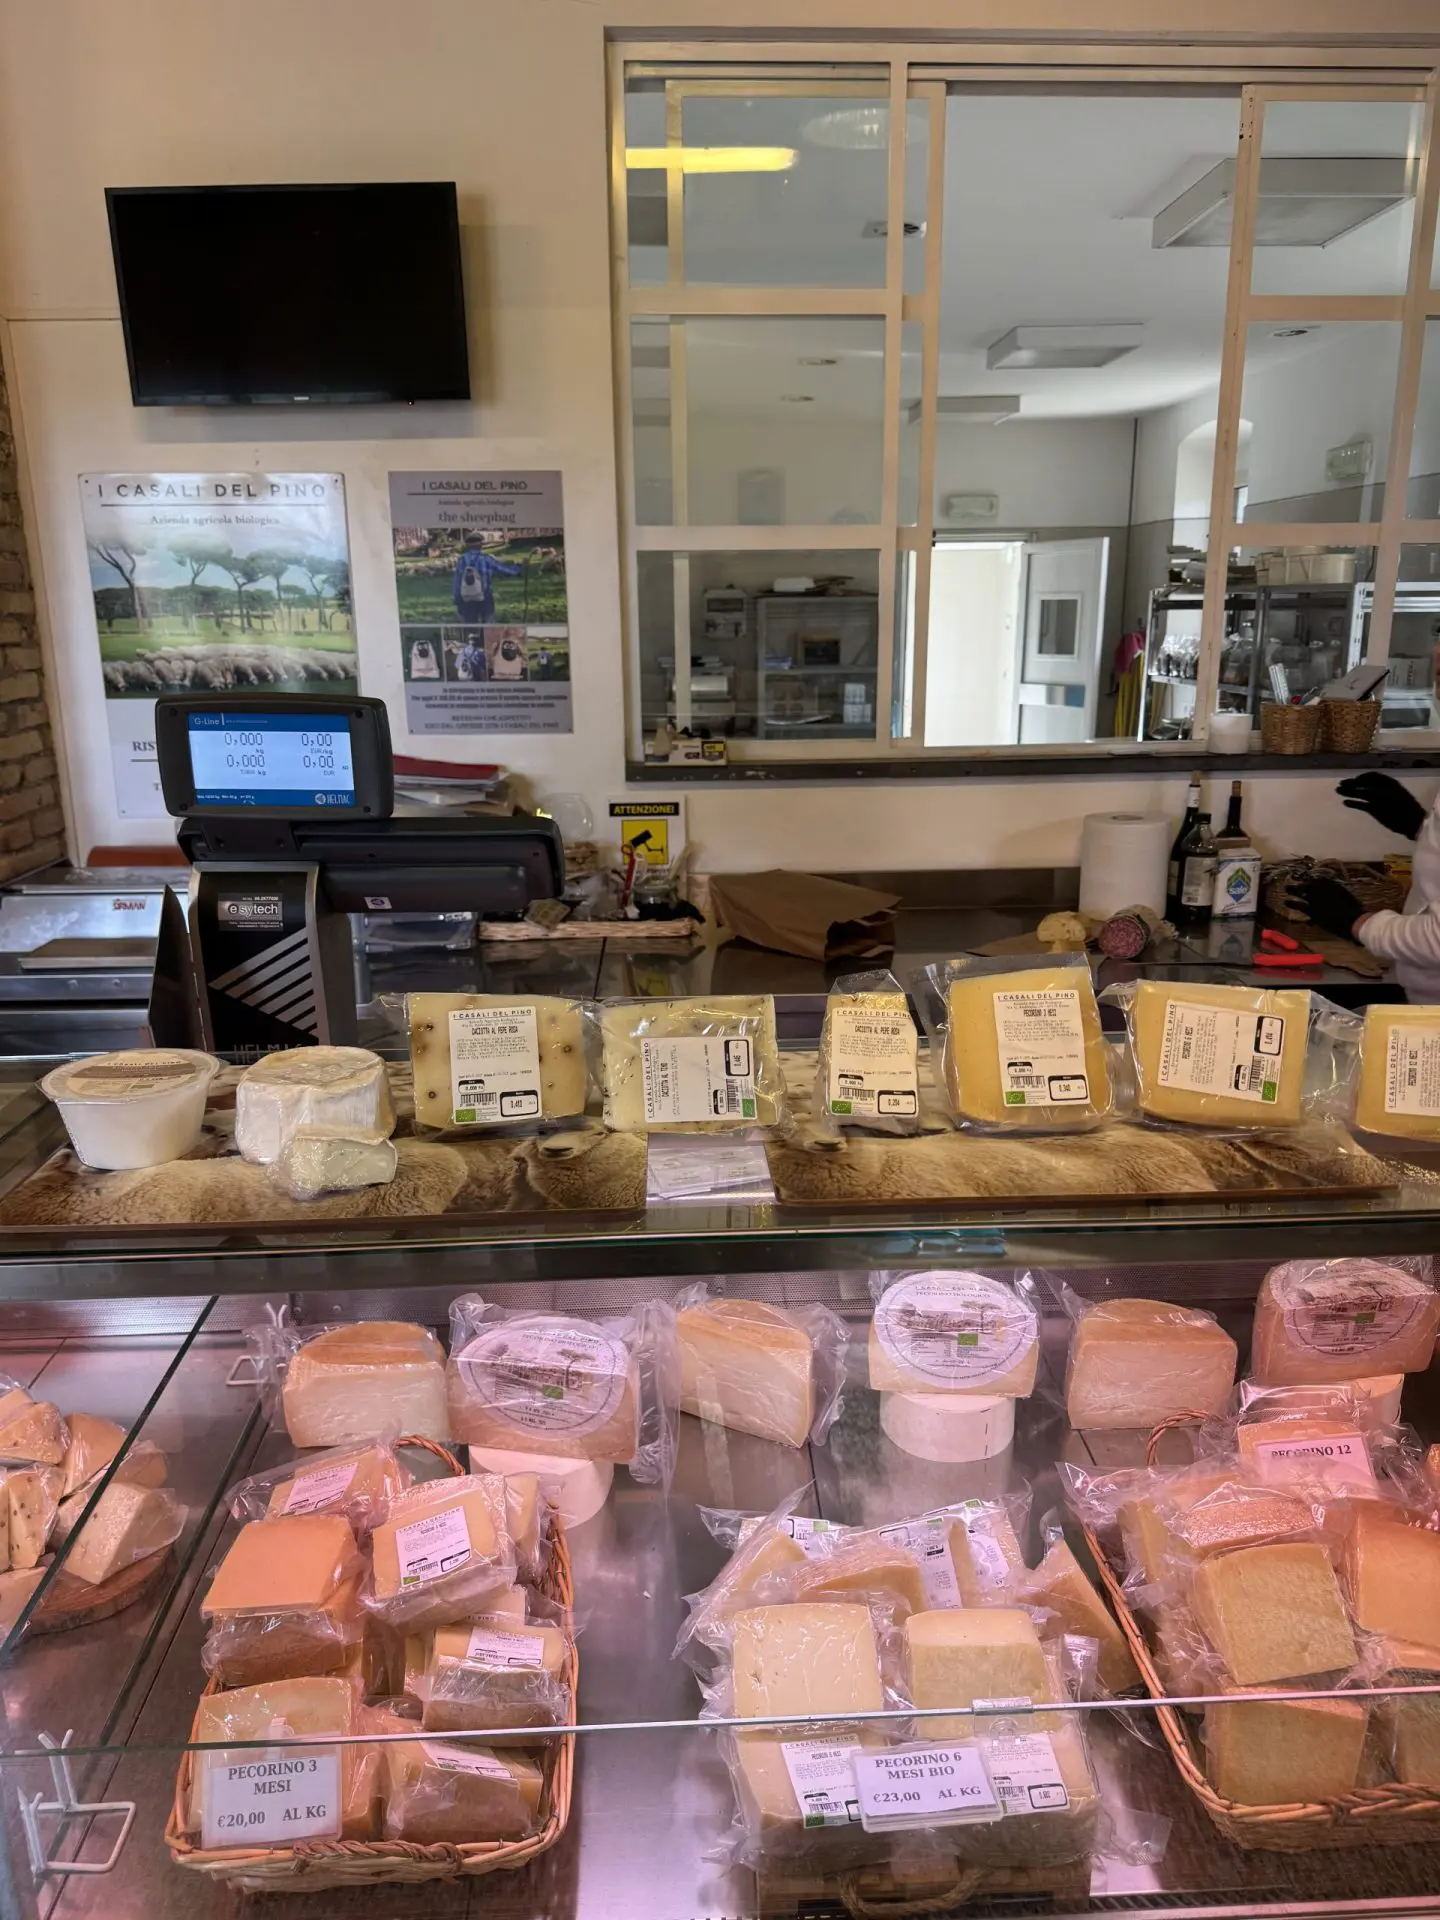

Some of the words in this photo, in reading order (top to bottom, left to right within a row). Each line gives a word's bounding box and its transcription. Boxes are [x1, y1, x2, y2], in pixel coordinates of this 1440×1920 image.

[98, 484, 103, 498] I
[116, 483, 202, 498] CASALI
[215, 483, 257, 498] DEL
[268, 483, 326, 498] PINO
[421, 481, 426, 491] I
[429, 481, 472, 492] CASALI
[474, 481, 497, 491] DEL
[500, 480, 528, 491] PINO
[150, 515, 190, 525] Azienda
[193, 515, 234, 528] agricola
[235, 515, 280, 528] biologica
[438, 512, 459, 522] the
[459, 512, 516, 525] sheepbag
[224, 733, 263, 747] 0,000
[301, 733, 332, 747] 0,00
[226, 754, 266, 768] 0,000
[303, 755, 334, 769] 0,00
[1168, 1004, 1176, 1025] PINO
[1165, 1027, 1174, 1043] DEL
[643, 1042, 651, 1062] PINO
[1162, 1044, 1172, 1077] CASALI
[1390, 1053, 1398, 1069] DEL
[645, 1065, 653, 1080] DEL
[1388, 1071, 1397, 1103] CASALI
[646, 1081, 655, 1113] CASALI
[1336, 1444, 1352, 1455] 12
[875, 1753, 950, 1769] PECORINO
[953, 1752, 962, 1764] 6
[228, 1760, 305, 1780] PECORINO
[309, 1759, 318, 1772] 3
[888, 1769, 925, 1781] MESI
[929, 1765, 955, 1778] BIO
[253, 1779, 292, 1796] MESI
[873, 1791, 922, 1804] €23,00
[938, 1788, 957, 1801] AL
[960, 1786, 982, 1799] KG
[217, 1810, 266, 1828] €20,00
[282, 1807, 302, 1822] AL
[305, 1804, 327, 1820] KG
